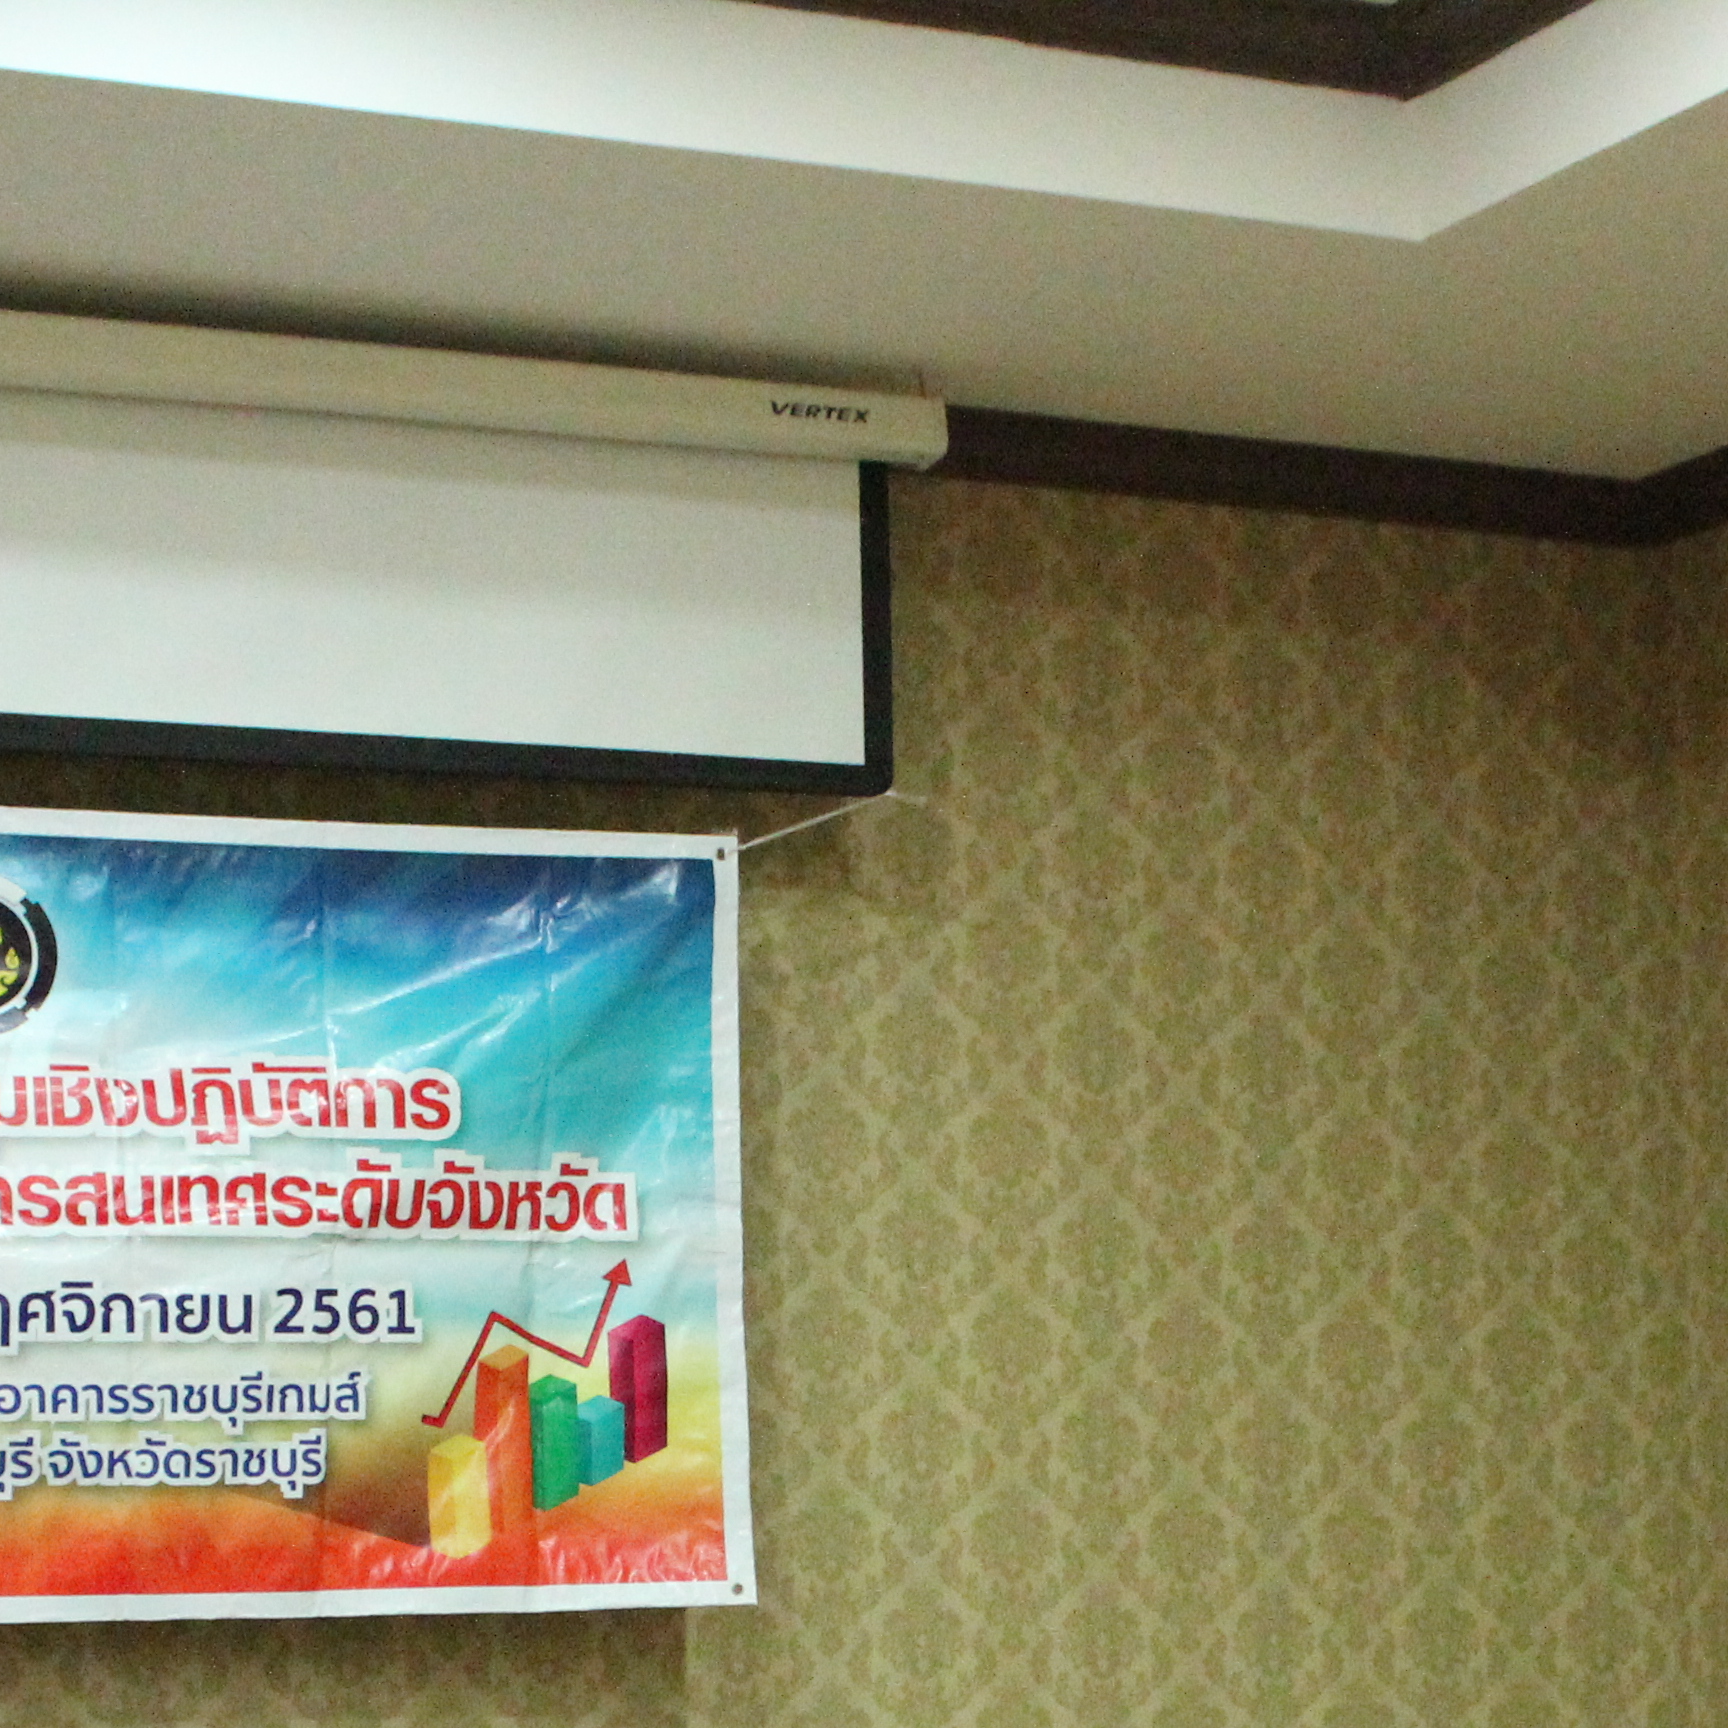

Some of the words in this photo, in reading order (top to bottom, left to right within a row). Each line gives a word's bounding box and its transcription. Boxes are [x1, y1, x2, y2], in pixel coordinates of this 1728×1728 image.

[770, 399, 871, 424] VERTEX
[274, 1287, 416, 1335] 2561
[47, 1433, 324, 1492] จังหวัดราชบุรี
